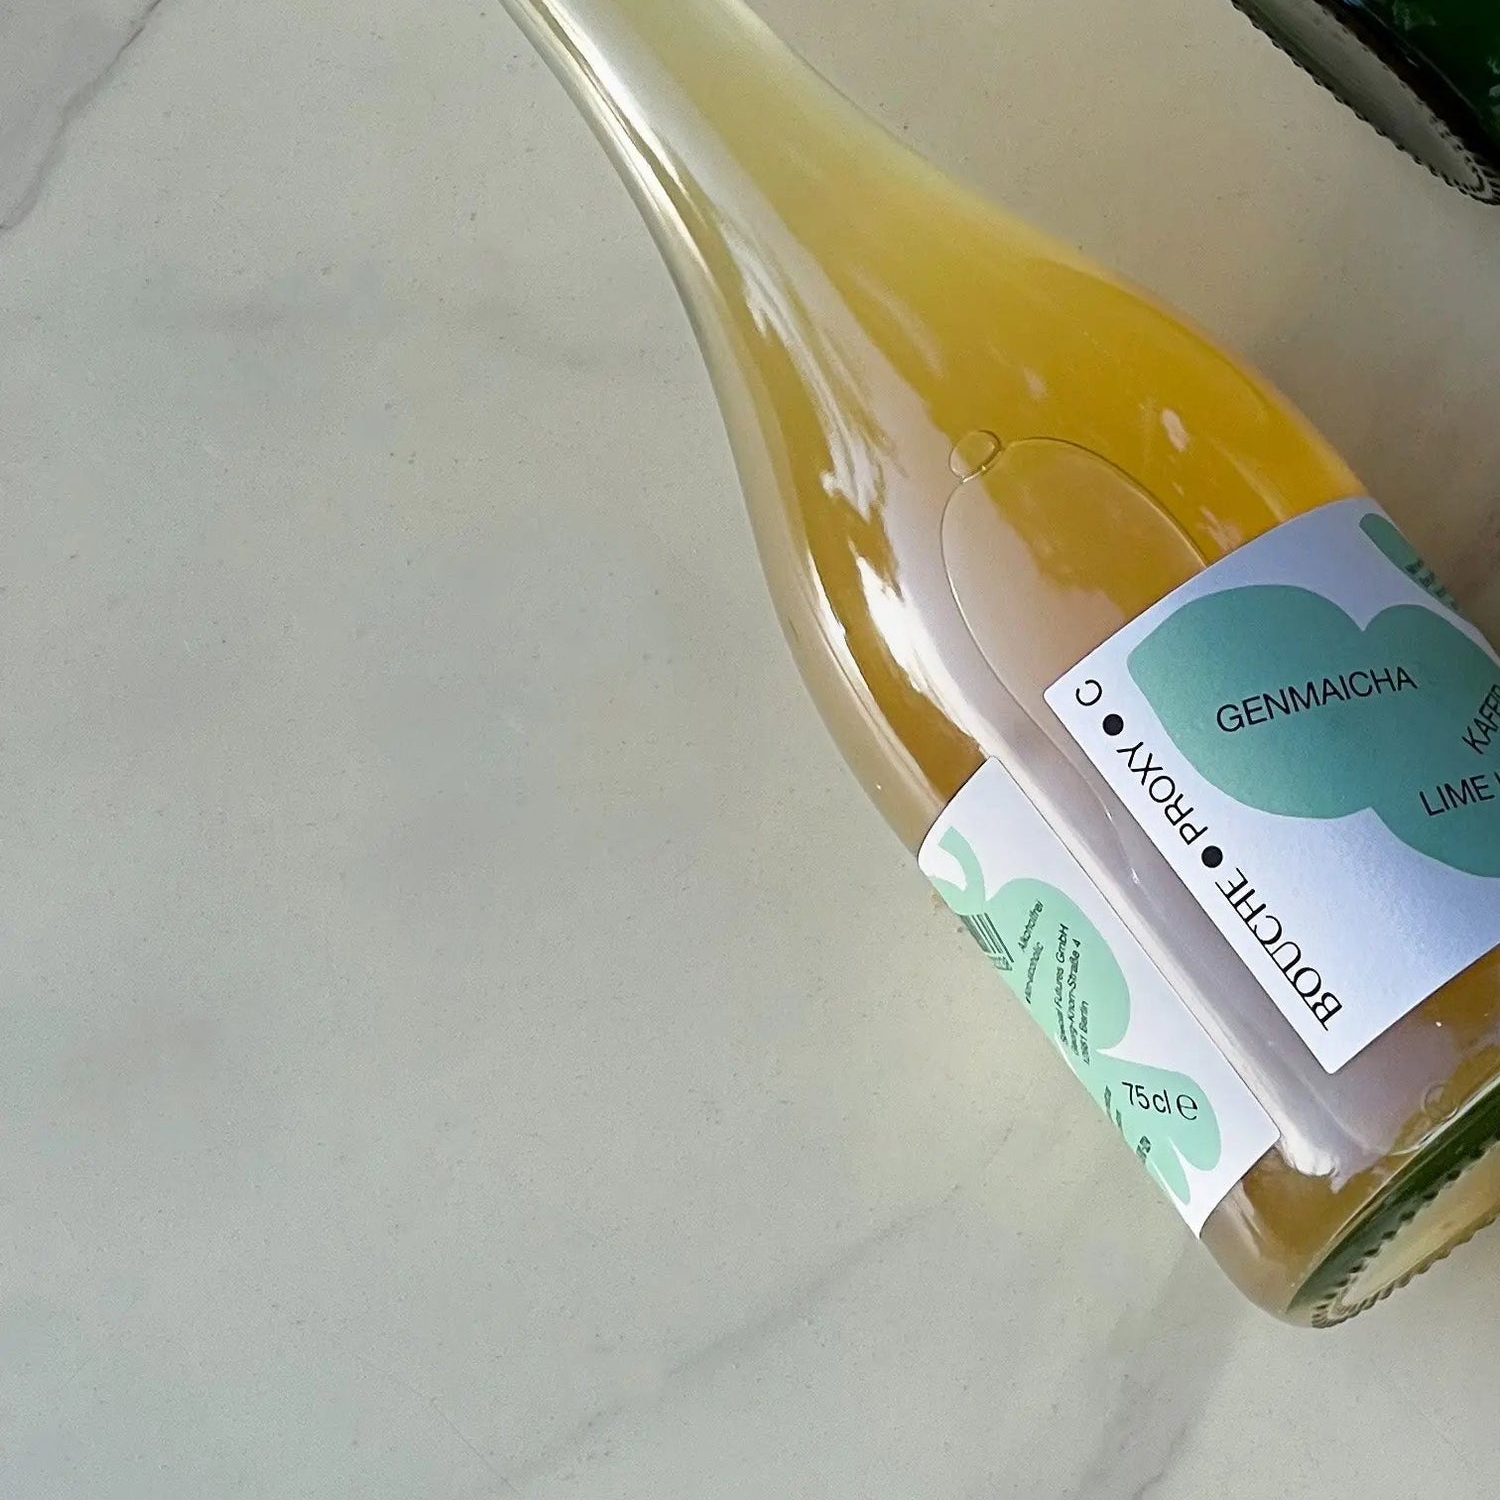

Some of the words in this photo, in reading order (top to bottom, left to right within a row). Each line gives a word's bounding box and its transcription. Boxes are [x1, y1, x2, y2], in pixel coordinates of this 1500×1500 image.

[1076, 680, 1102, 706] C
[1217, 667, 1417, 732] GENMAICHA
[1116, 742, 1208, 845] PROXY
[1420, 775, 1495, 816] LIME
[1055, 923, 1069, 964] GmbH
[1072, 938, 1081, 948] 4
[1215, 868, 1342, 1031] BOUCHE
[1054, 965, 1065, 1009] Futures
[1079, 1000, 1089, 1034] Berlin
